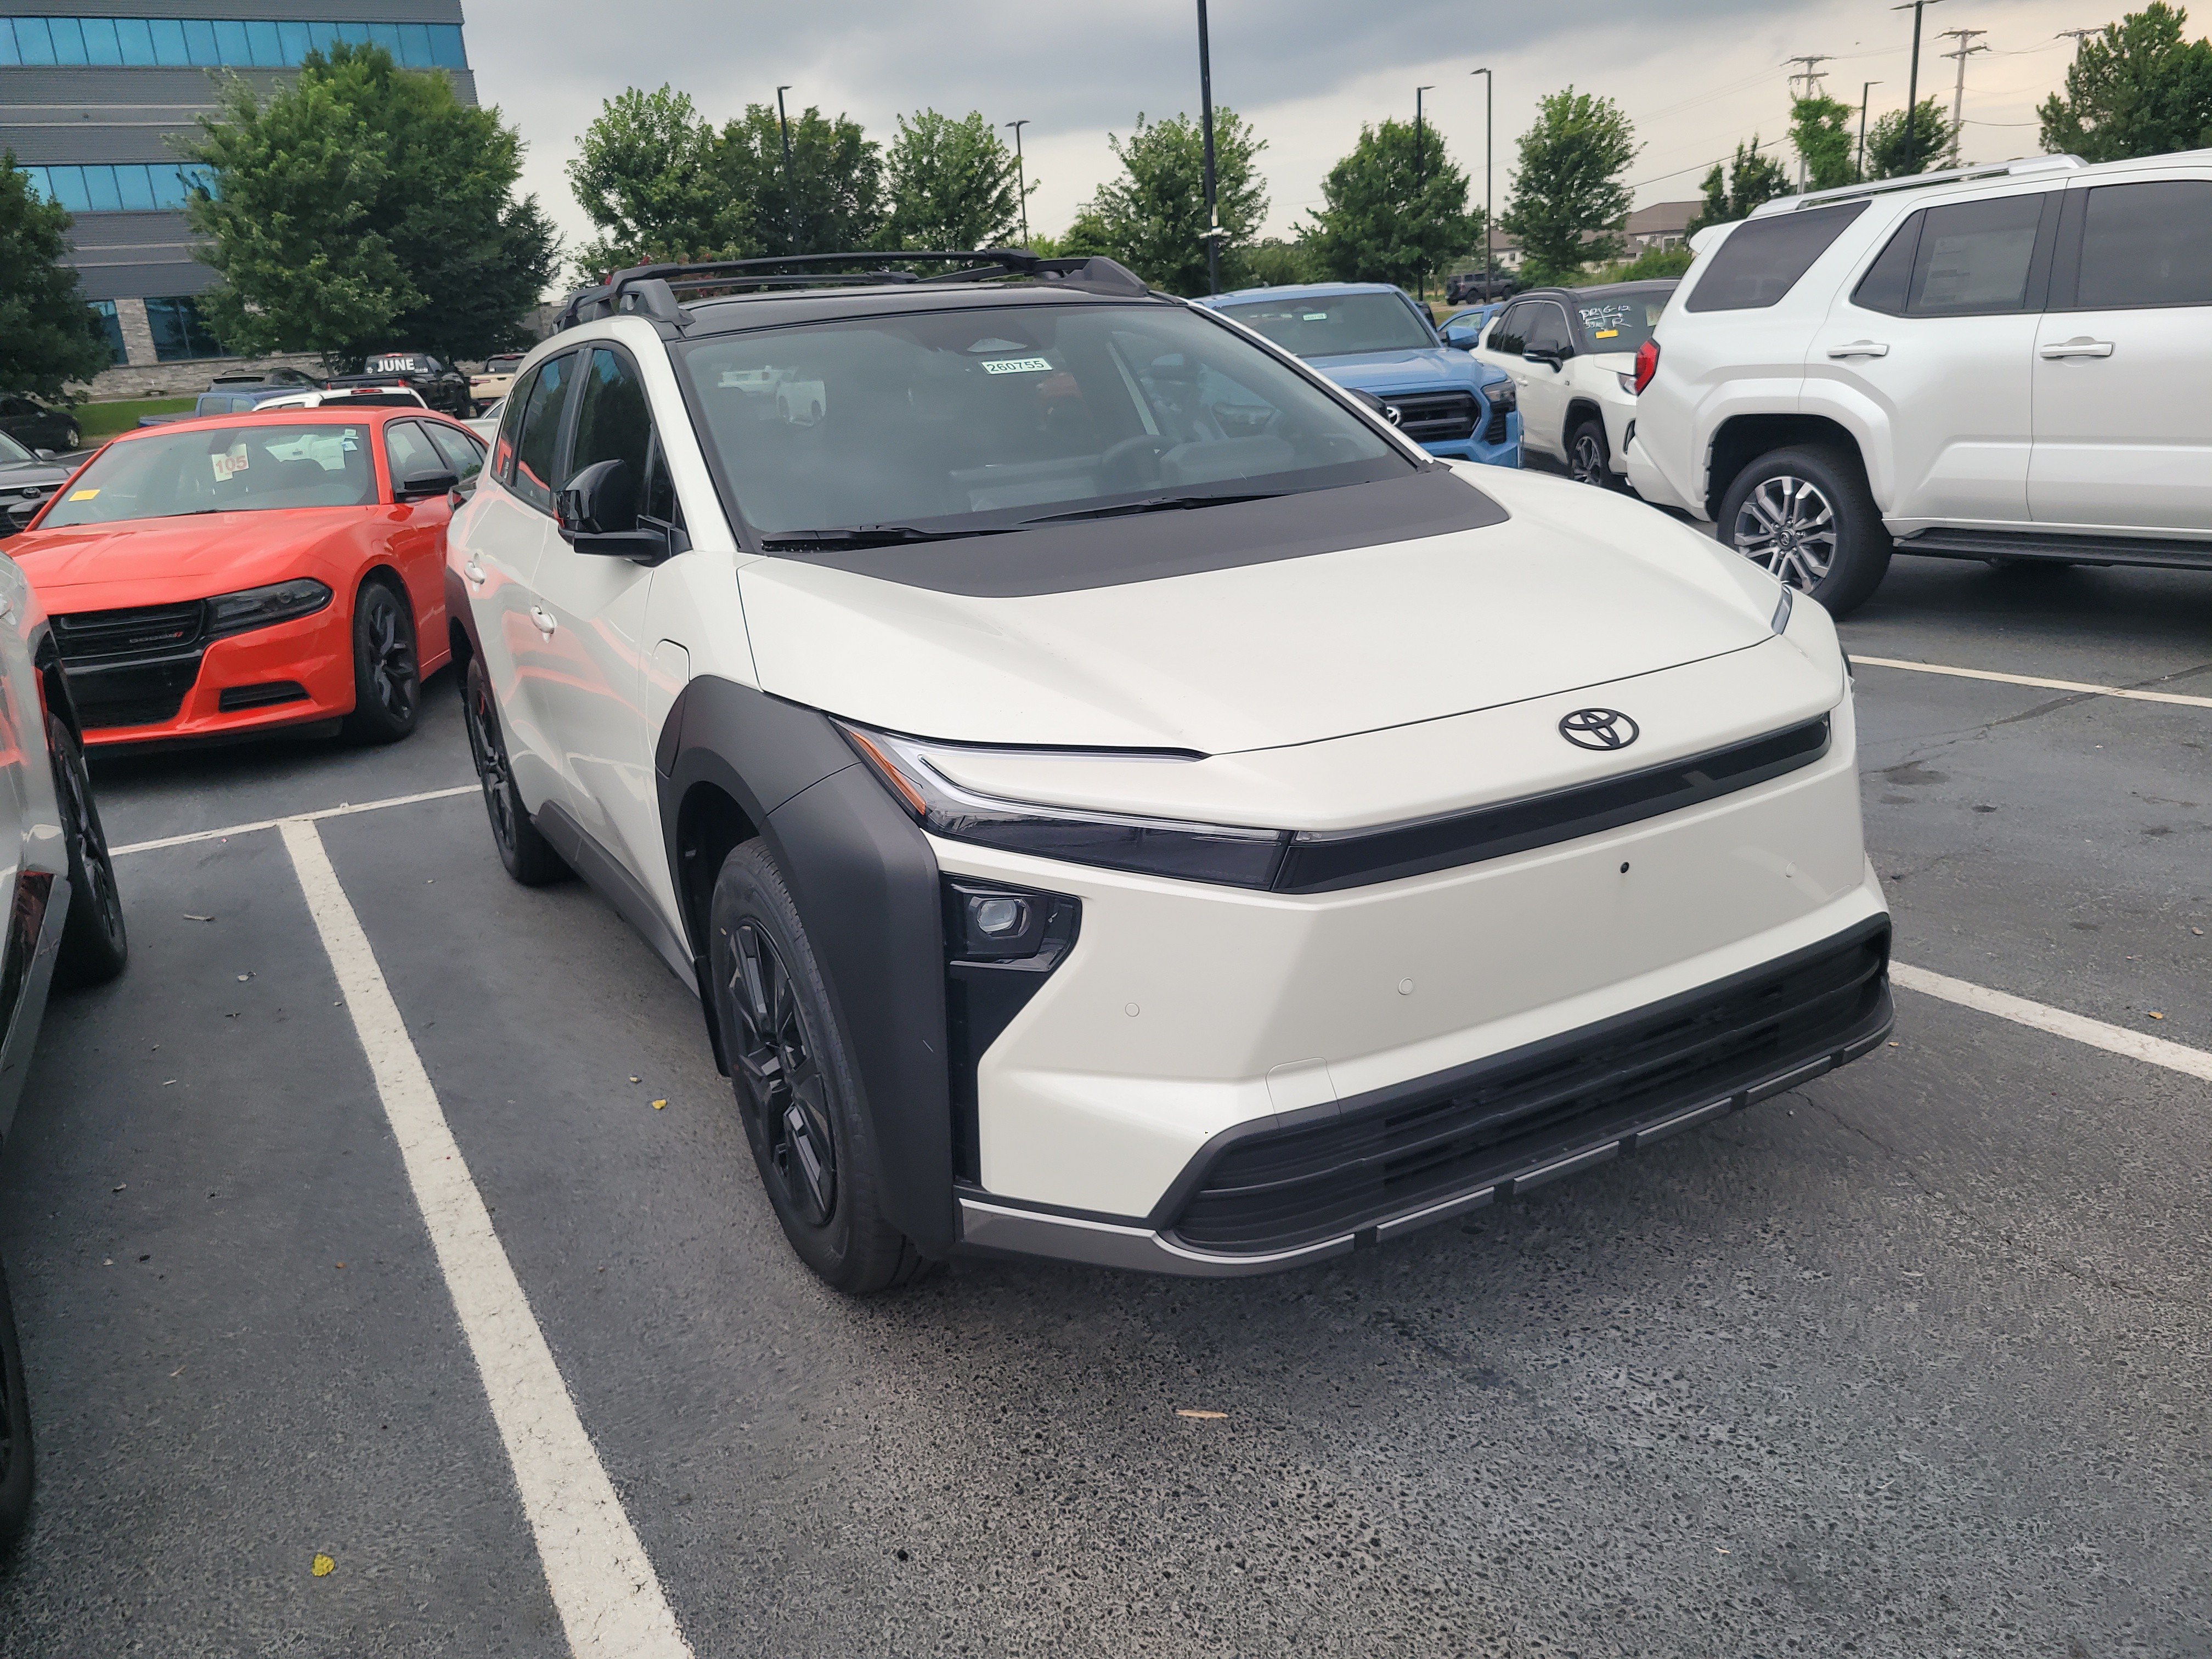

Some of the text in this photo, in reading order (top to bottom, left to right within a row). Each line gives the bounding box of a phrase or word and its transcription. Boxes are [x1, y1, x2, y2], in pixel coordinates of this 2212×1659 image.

[377, 358, 415, 372] JUNE
[986, 360, 1044, 371] 260755
[216, 455, 247, 473] 105
